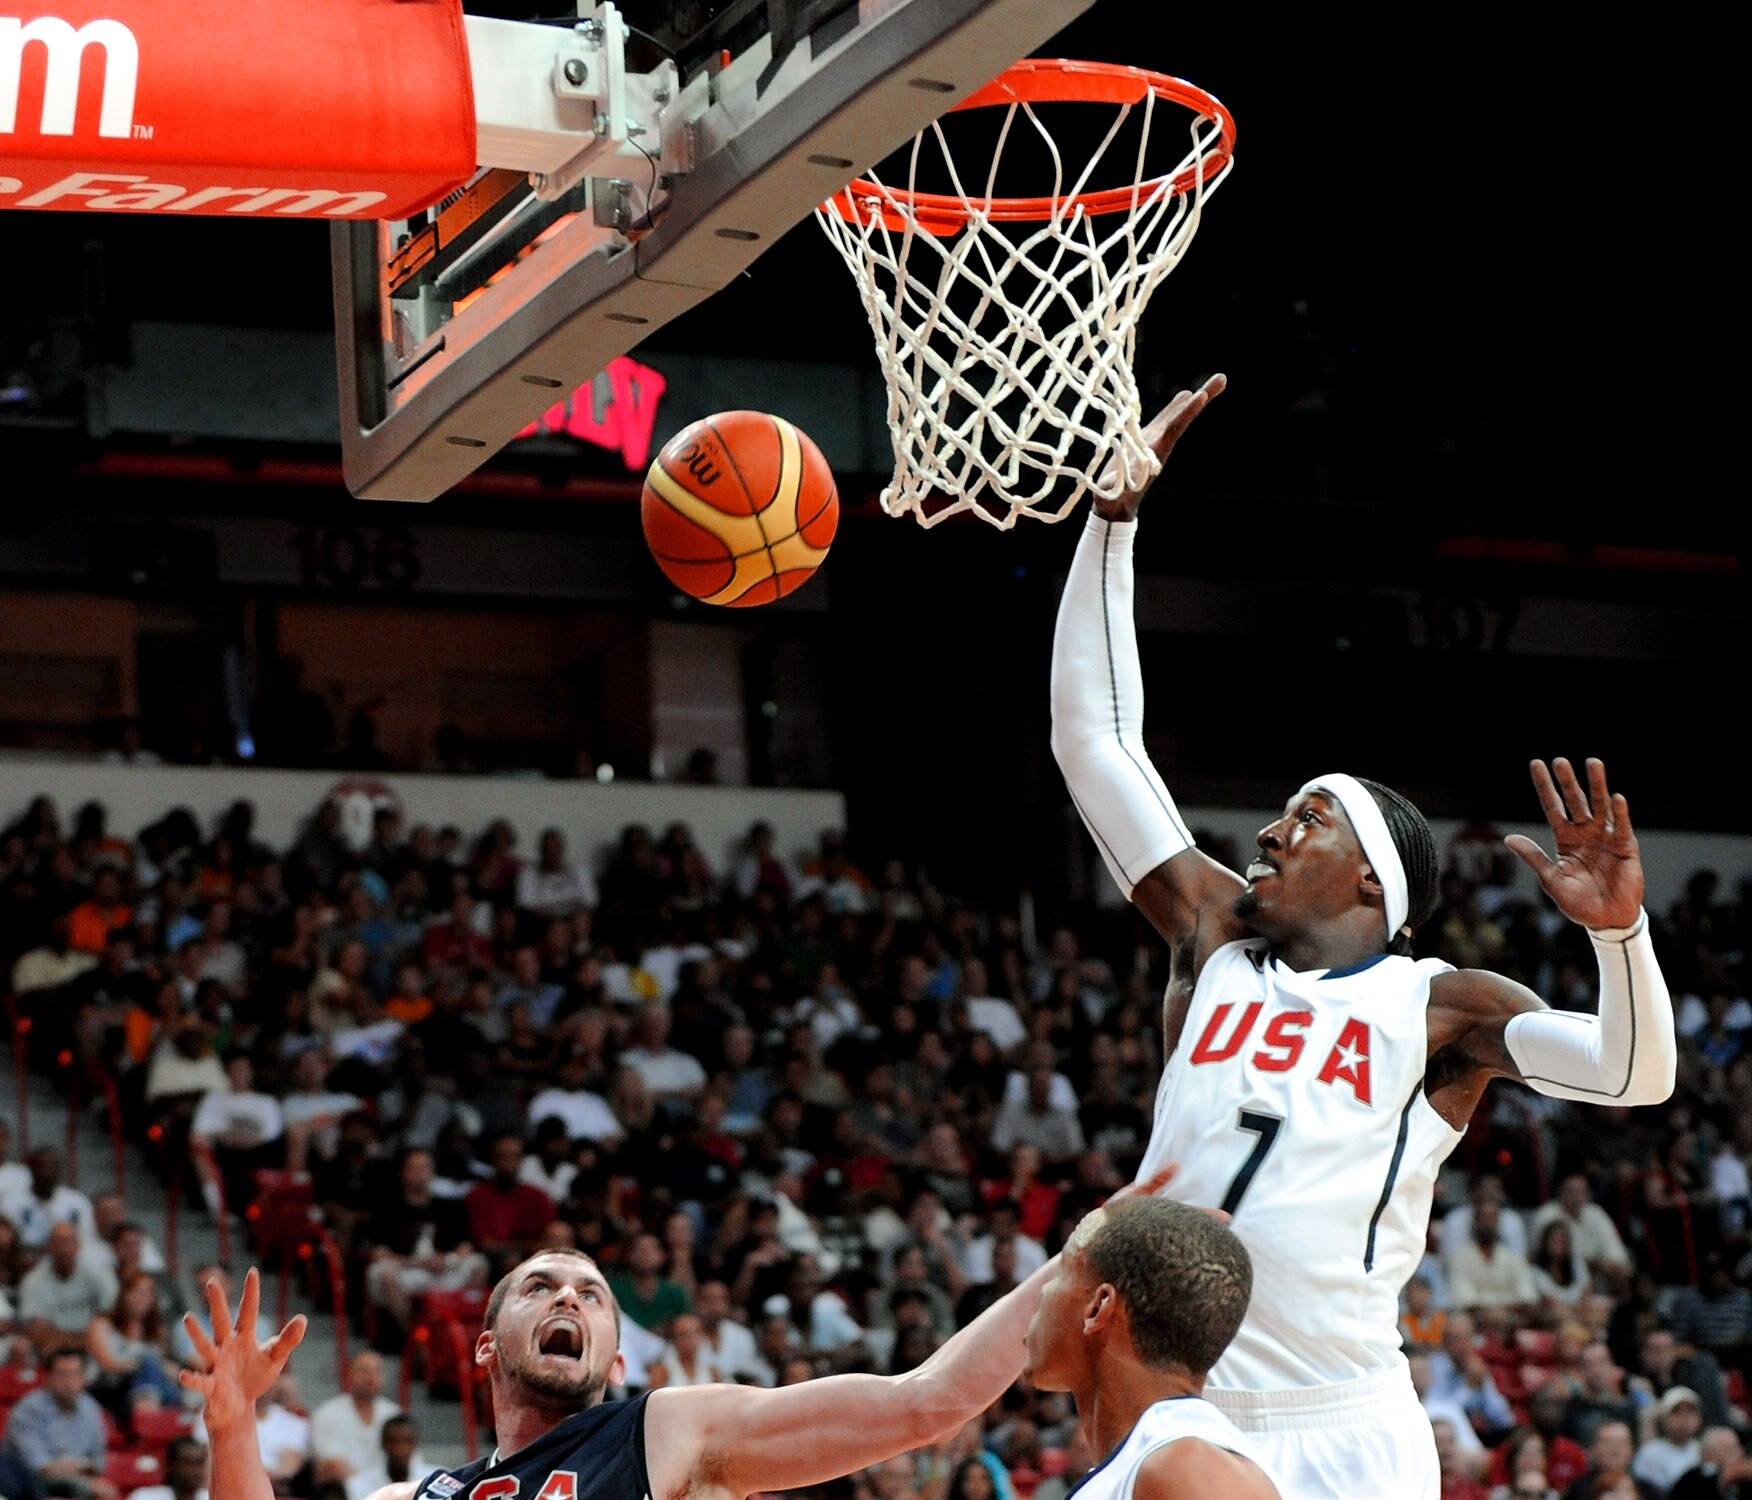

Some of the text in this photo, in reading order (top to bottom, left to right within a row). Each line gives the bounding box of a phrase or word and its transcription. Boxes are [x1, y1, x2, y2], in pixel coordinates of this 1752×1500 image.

[15, 171, 388, 216] Farm
[290, 526, 422, 590] 106
[1189, 1000, 1374, 1107] USA
[1219, 1106, 1286, 1214] 7
